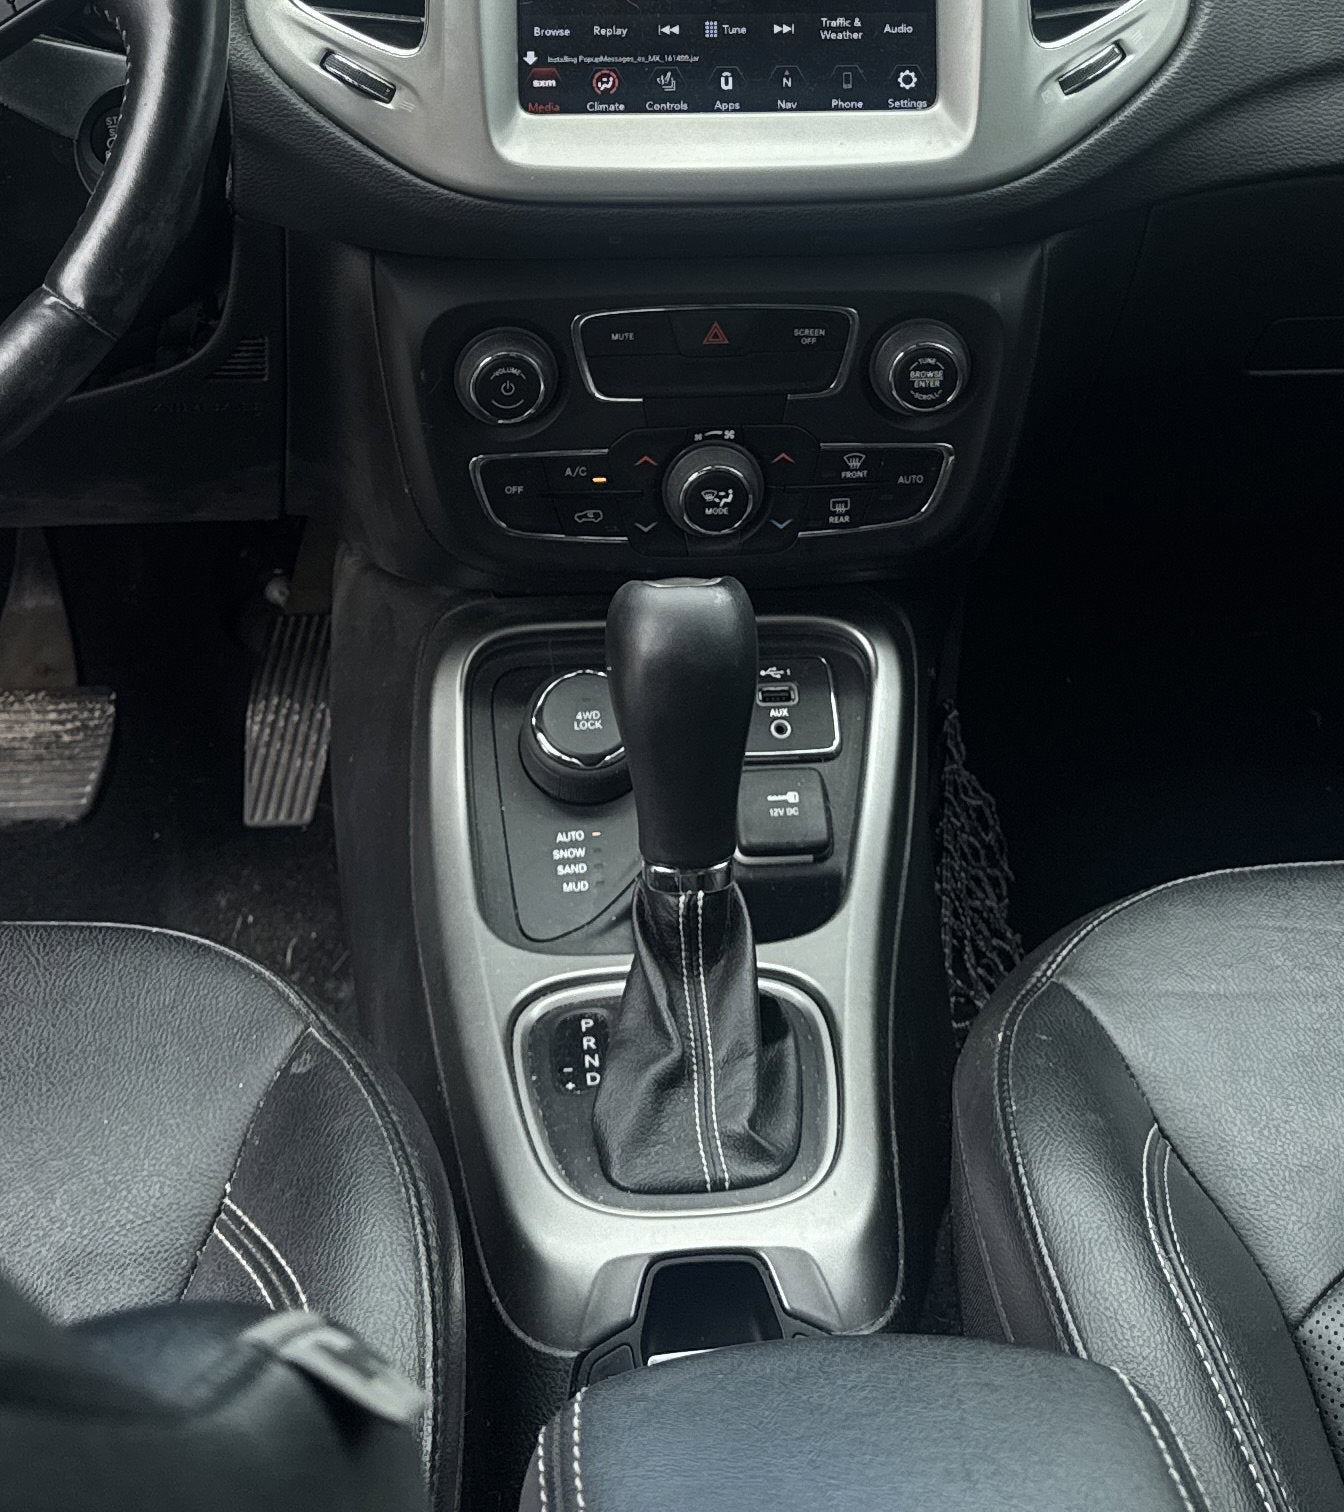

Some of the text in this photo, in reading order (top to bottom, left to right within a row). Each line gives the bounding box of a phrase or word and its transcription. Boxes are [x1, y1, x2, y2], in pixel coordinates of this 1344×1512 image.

[820, 17, 862, 28] Traffic &
[533, 26, 571, 37] Browse
[593, 26, 628, 38] Replay
[722, 24, 747, 34] Tune
[883, 23, 914, 34] Audio
[820, 29, 864, 40] Weather
[528, 102, 561, 112] Media
[586, 102, 626, 112] Climate
[645, 100, 689, 111] Controls
[714, 100, 741, 111] Apps
[777, 99, 798, 110] Nav
[831, 98, 863, 109] Phone
[887, 98, 928, 111] Settings
[611, 332, 635, 341] MUTE
[793, 328, 826, 337] SCREEN
[800, 337, 817, 345] OFF
[909, 370, 944, 379] BROWSE
[913, 379, 941, 388] ENTER
[913, 391, 940, 401] SCROLL
[564, 466, 588, 477] A/C
[841, 470, 868, 479] FRONT
[897, 474, 924, 485] AUTO
[504, 485, 524, 495] OFF
[705, 506, 729, 516] MODE
[828, 515, 851, 524] REAR
[575, 710, 601, 721] 4WD
[769, 707, 789, 718] AUX
[573, 720, 603, 731] LOCK
[769, 807, 800, 817] 12V DC
[555, 829, 585, 844] AUTO
[552, 846, 586, 861] SNOW
[556, 862, 588, 877] SAND
[562, 879, 590, 893] MUD
[580, 1018, 594, 1033] P
[582, 1036, 597, 1051] R
[584, 1054, 600, 1068] N
[586, 1072, 601, 1087] D
